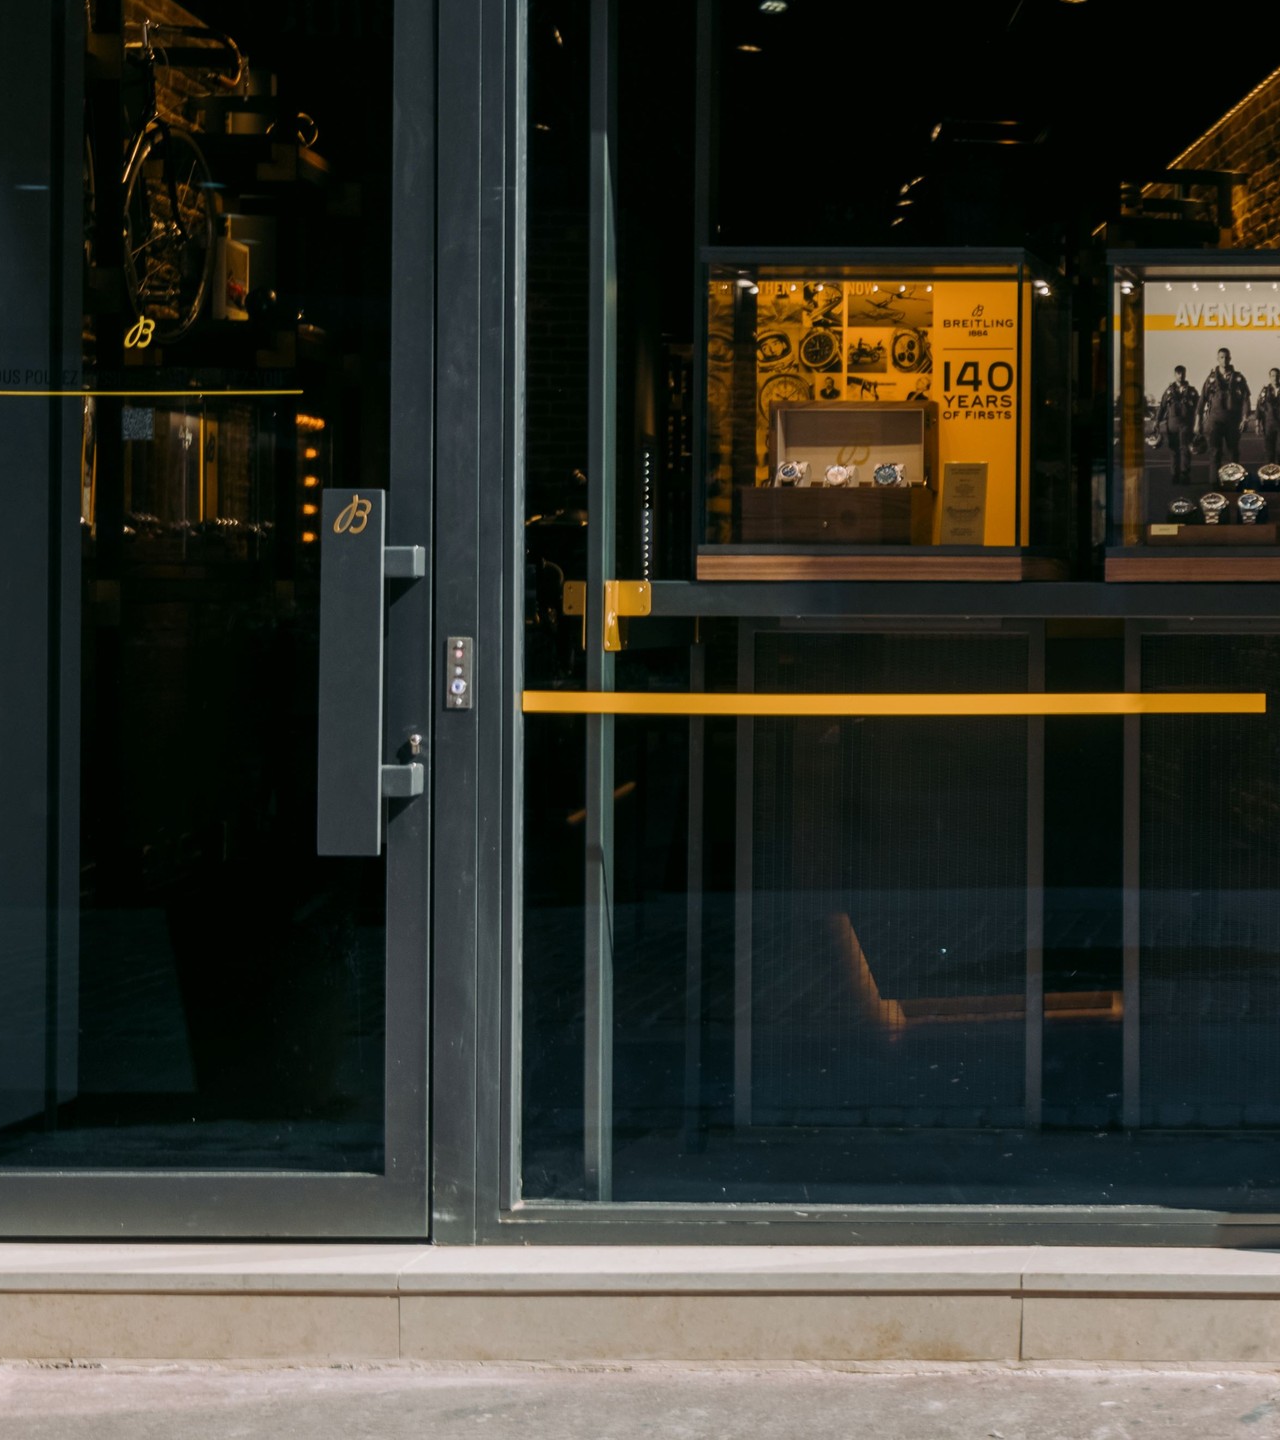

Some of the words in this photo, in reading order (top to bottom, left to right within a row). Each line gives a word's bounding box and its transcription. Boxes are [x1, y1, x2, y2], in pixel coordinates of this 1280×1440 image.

[848, 282, 875, 295] NOW
[943, 318, 1014, 329] BREITLING
[968, 329, 989, 337] 1884
[943, 361, 1014, 392] 140
[943, 395, 1013, 409] YEARS
[943, 411, 961, 420] OF
[965, 411, 1012, 420] FIRSTS
